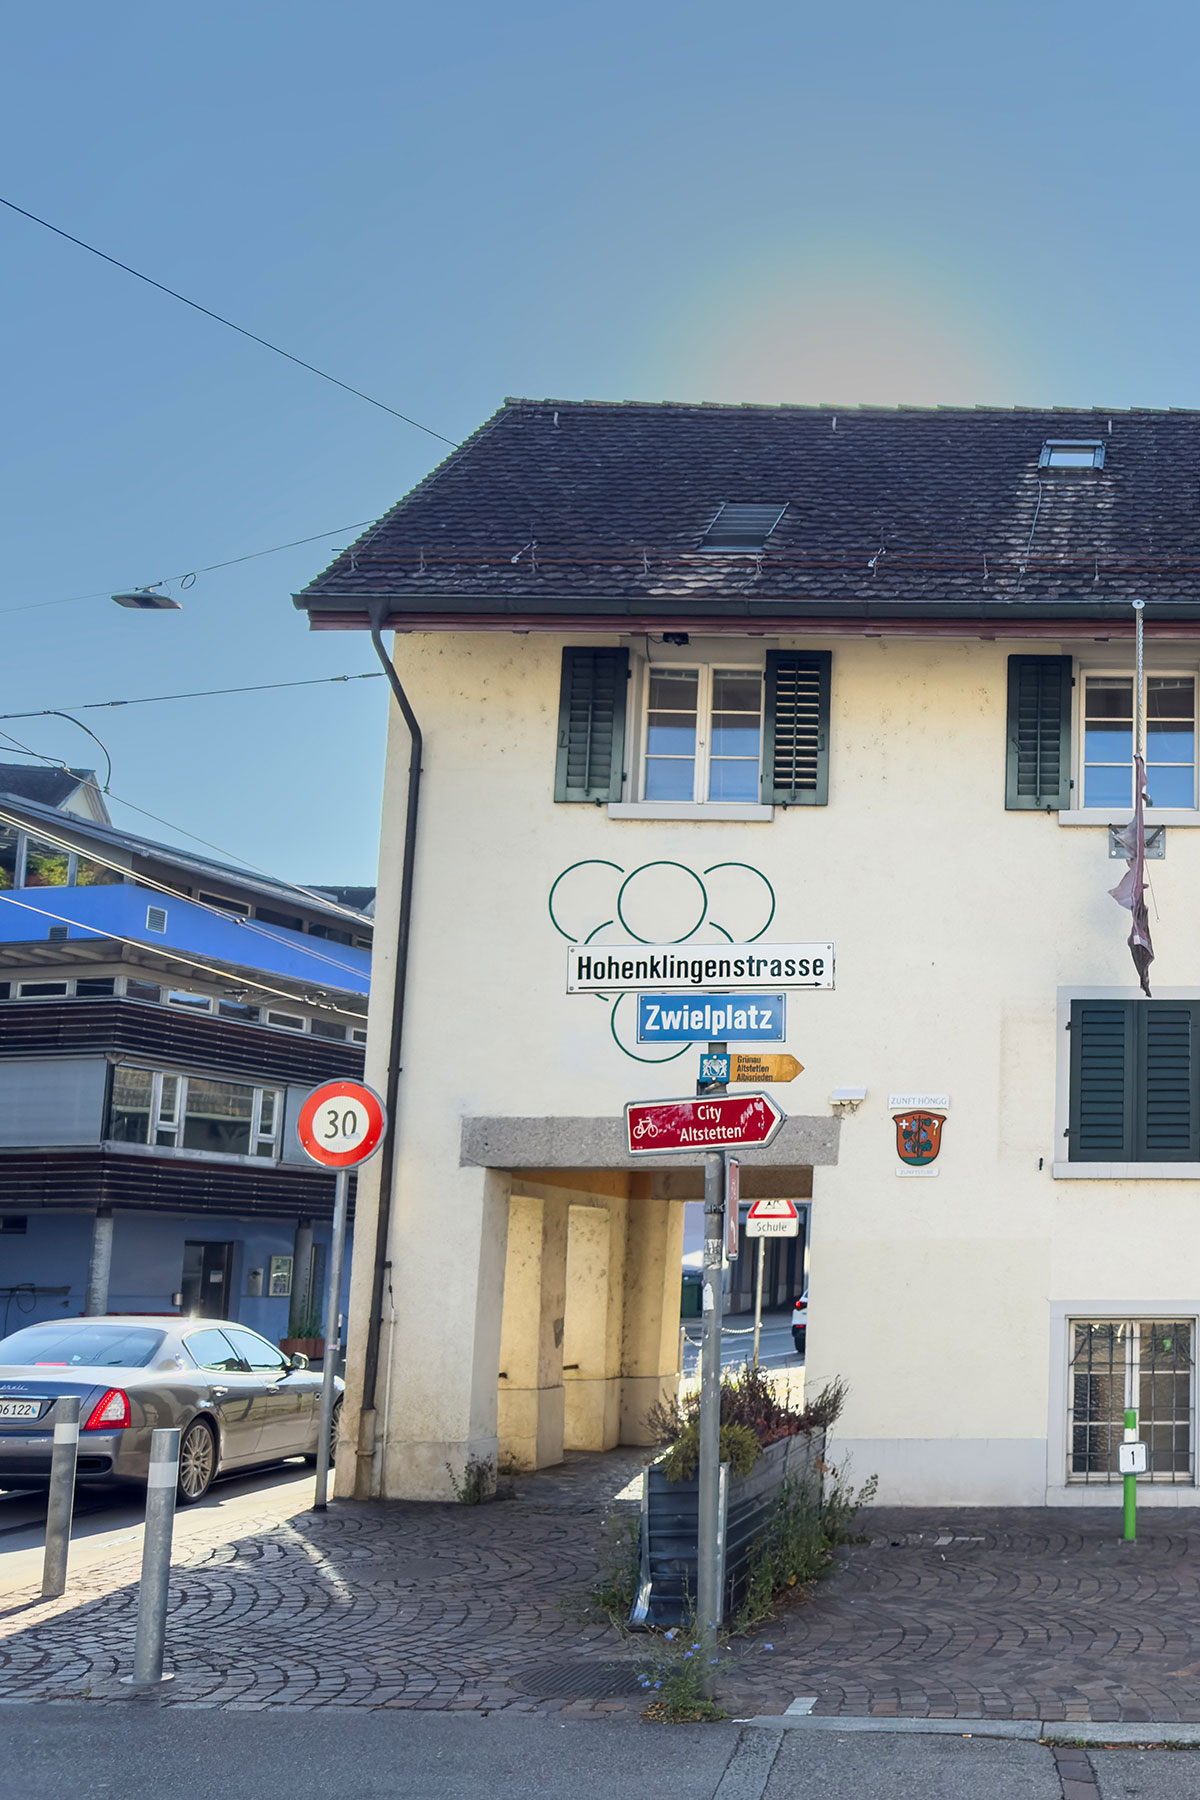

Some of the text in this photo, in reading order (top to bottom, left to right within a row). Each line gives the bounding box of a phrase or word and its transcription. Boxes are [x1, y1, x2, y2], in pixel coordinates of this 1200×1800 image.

[577, 955, 824, 983] Hohenklingenstrasse
[645, 1005, 772, 1035] Zwielplatz
[737, 1055, 761, 1063] Grünau
[737, 1064, 769, 1073] Altstetten
[737, 1073, 773, 1082] Albisrieden
[891, 1096, 947, 1105] ZUNFT HÖNGG
[697, 1105, 722, 1123] City
[324, 1110, 357, 1139] 30
[680, 1126, 742, 1142] Altstetten
[756, 1221, 788, 1232] Schule
[1131, 1451, 1135, 1466] 1
